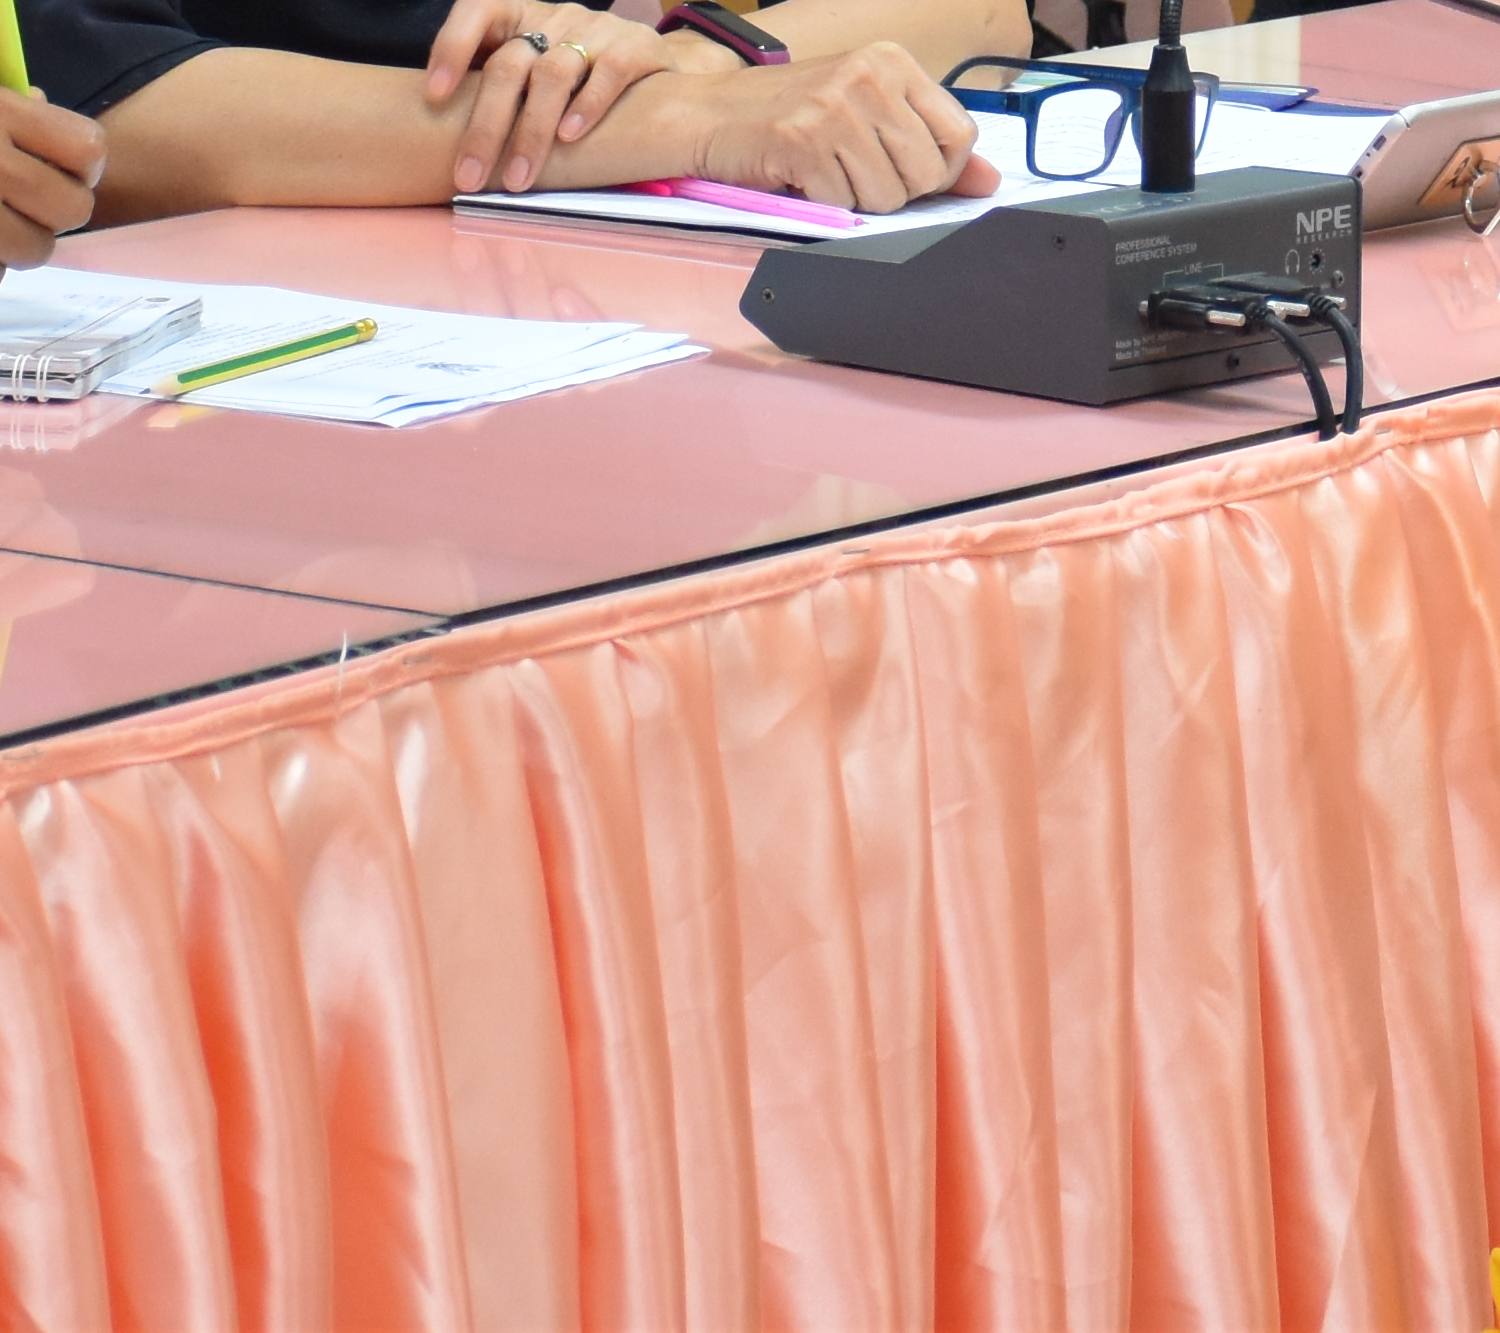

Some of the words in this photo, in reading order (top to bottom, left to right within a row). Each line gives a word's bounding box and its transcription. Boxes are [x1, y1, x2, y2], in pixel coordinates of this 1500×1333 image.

[1296, 204, 1352, 236] NPE
[1115, 235, 1171, 253] PROFESSIONAL
[1115, 247, 1166, 265] CONFERENCE
[1167, 242, 1197, 257] SYSTEM
[1184, 262, 1203, 275] LINE
